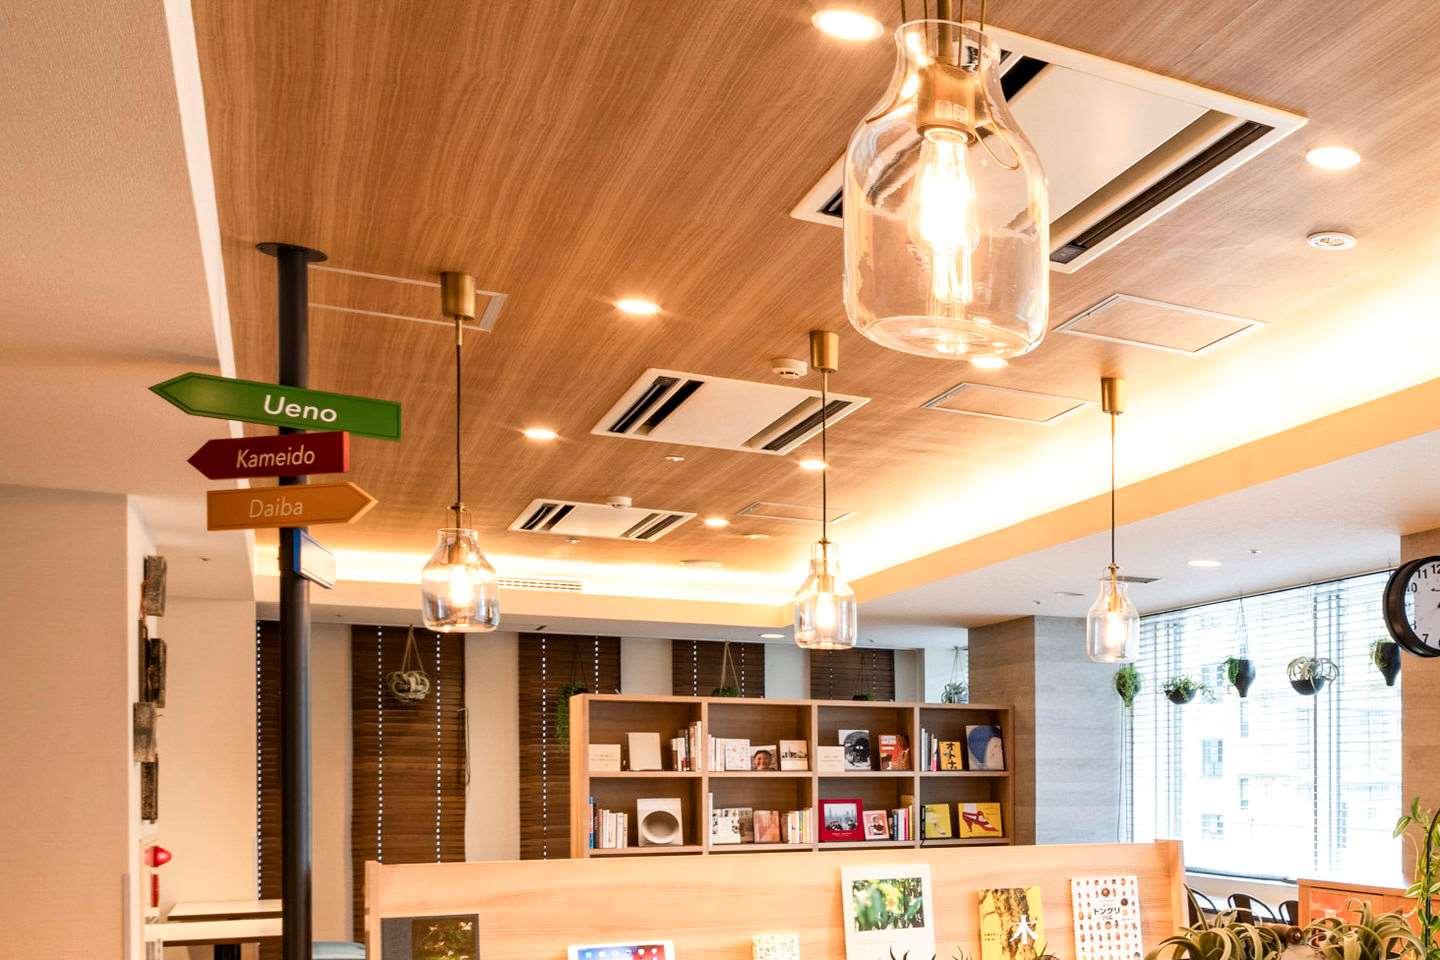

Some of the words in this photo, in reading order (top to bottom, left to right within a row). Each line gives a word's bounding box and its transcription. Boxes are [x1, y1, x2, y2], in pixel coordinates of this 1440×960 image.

[264, 394, 337, 422] Ueno
[236, 445, 315, 469] Kameido
[250, 499, 303, 518] Daiba
[1417, 569, 1428, 579] 11
[1422, 633, 1429, 644] 7
[1010, 914, 1037, 944] 木
